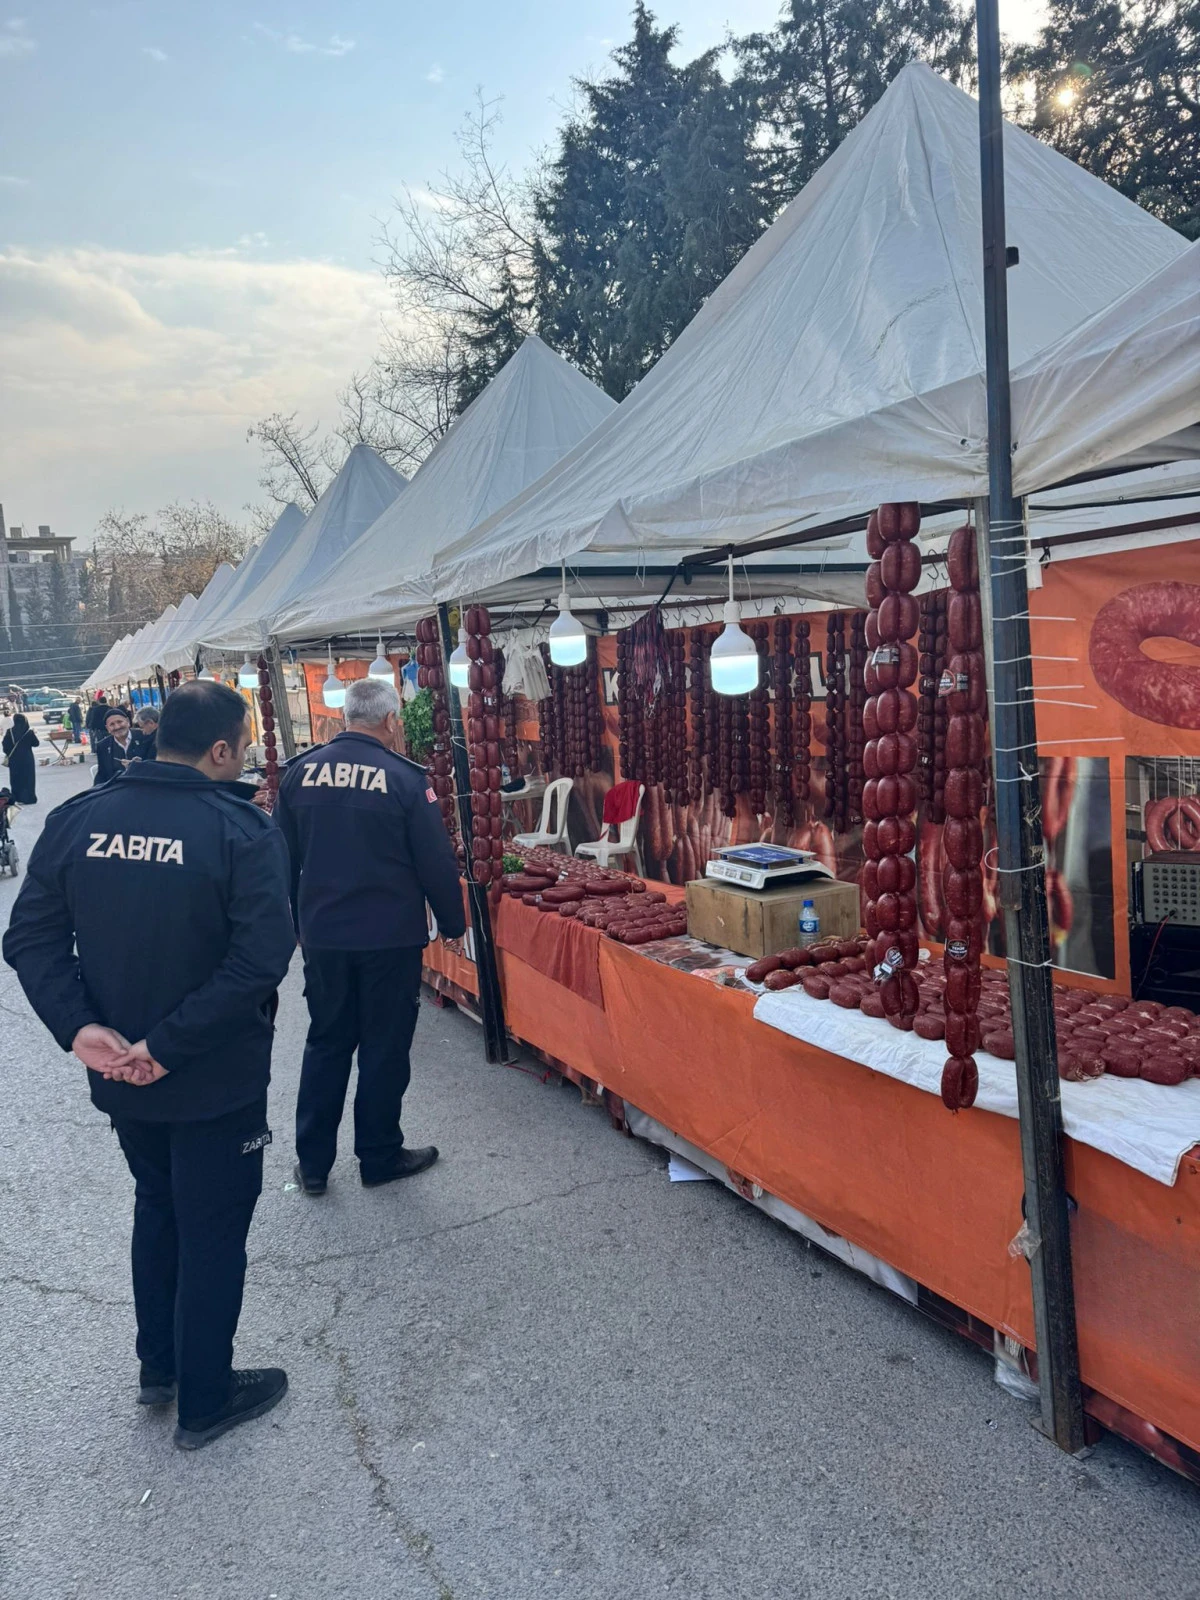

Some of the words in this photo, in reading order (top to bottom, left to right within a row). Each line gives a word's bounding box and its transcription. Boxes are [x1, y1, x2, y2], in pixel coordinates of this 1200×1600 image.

[302, 762, 388, 793] ZABITA
[86, 833, 184, 865] ZABITA
[242, 1133, 271, 1154] ZABITA
